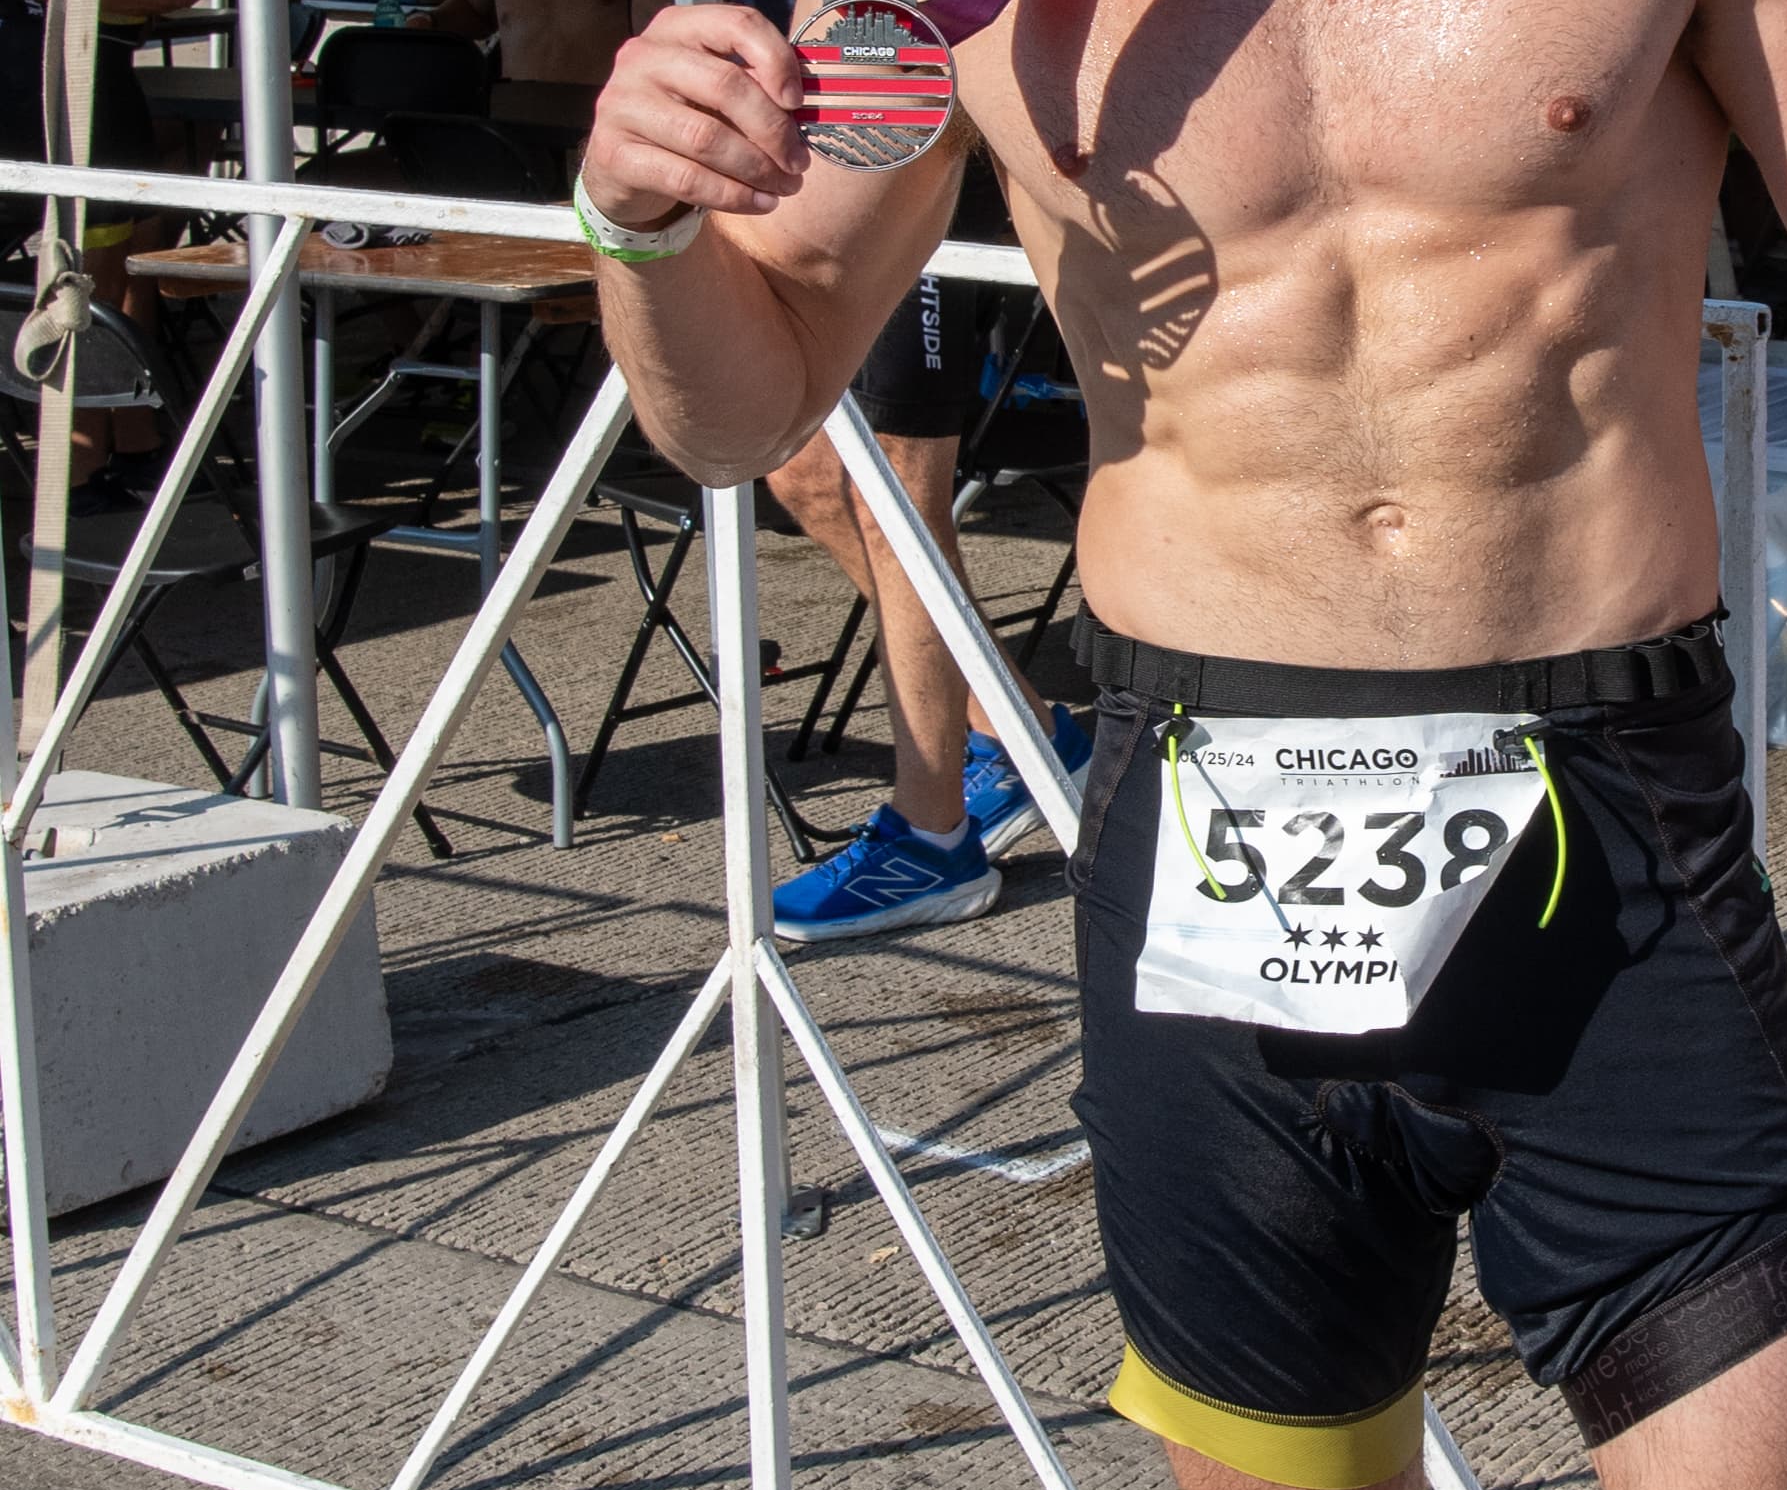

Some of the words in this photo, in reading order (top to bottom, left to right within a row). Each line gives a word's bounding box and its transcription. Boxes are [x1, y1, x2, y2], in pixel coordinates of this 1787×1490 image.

[843, 46, 896, 57] CHICAGO
[921, 274, 942, 370] HTSIDE
[1178, 750, 1255, 767] 08/25/24
[1276, 748, 1418, 771] CHICAGO
[1280, 776, 1420, 786] TRIATHLON
[1195, 808, 1509, 908] 5238
[1259, 957, 1398, 985] OLYMPI
